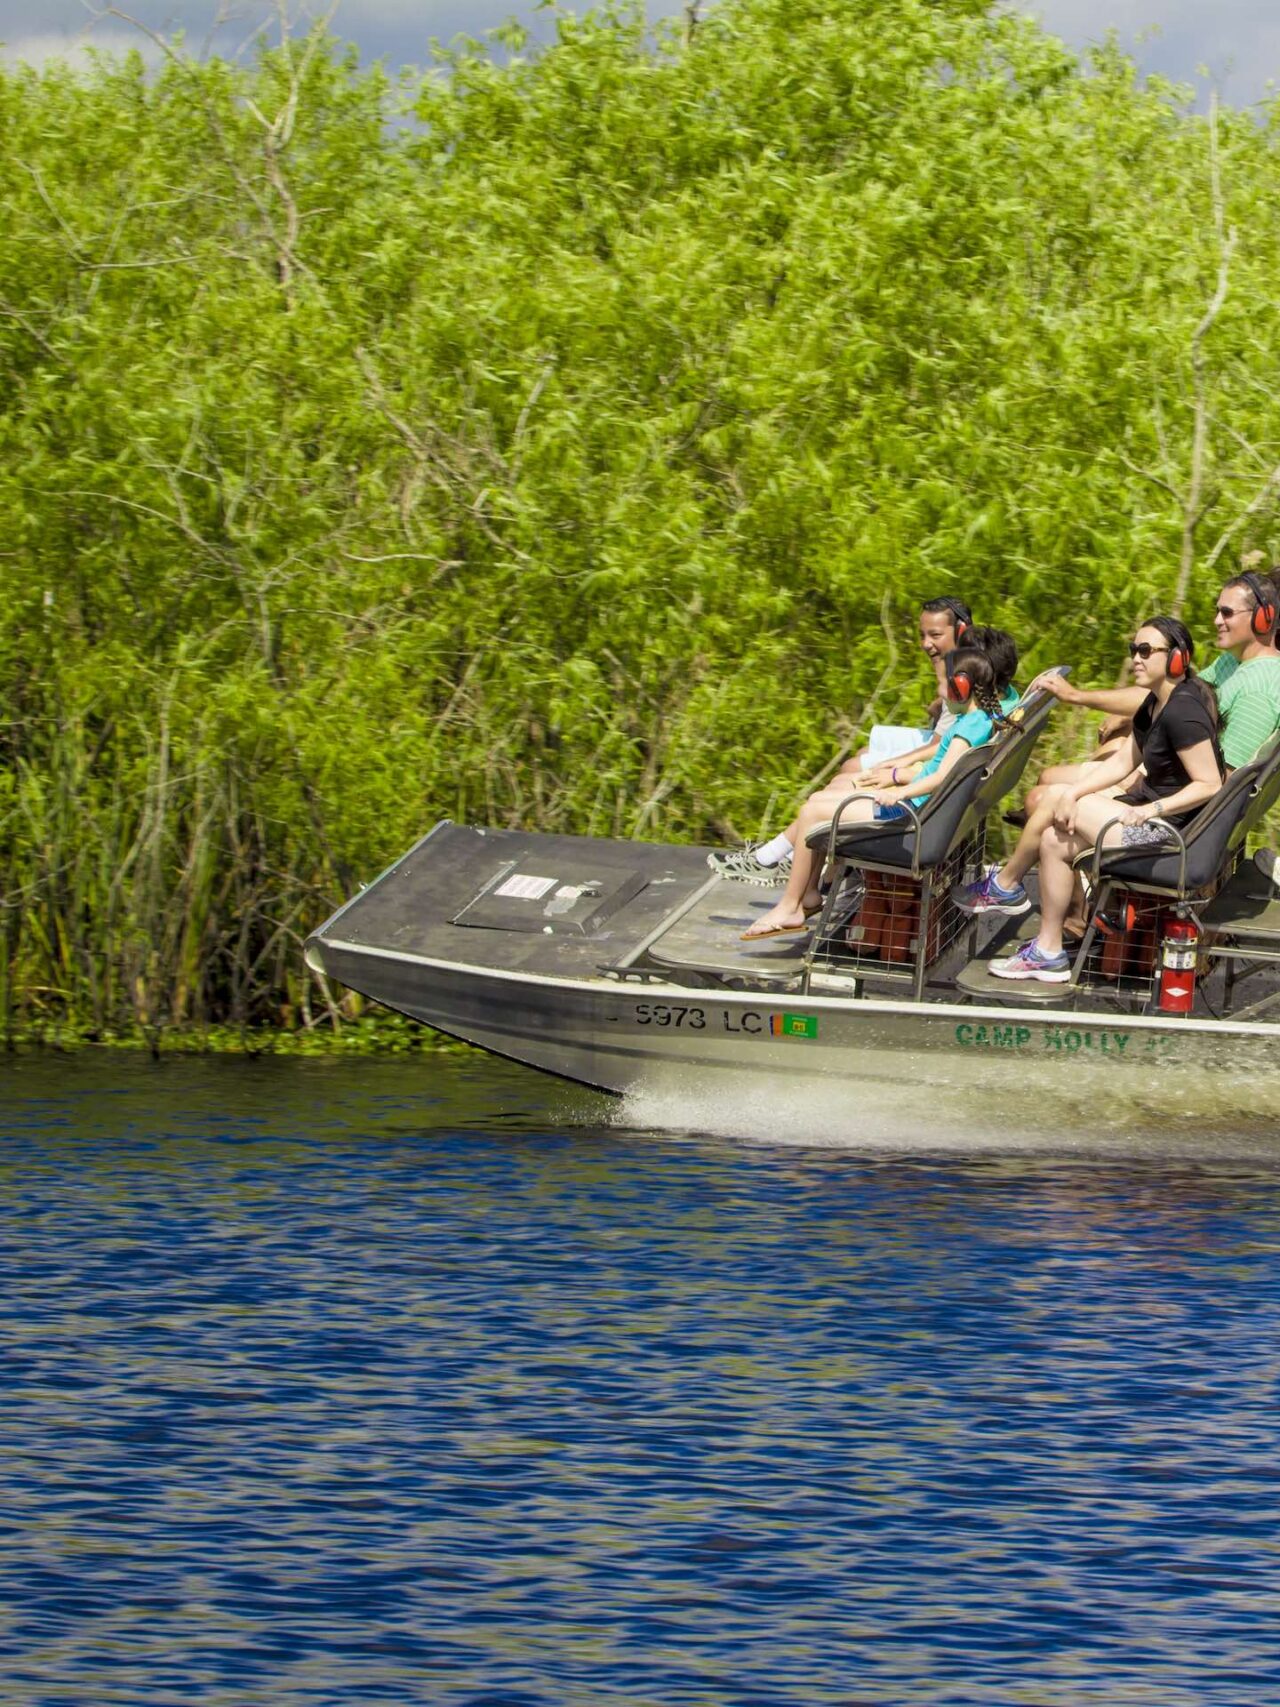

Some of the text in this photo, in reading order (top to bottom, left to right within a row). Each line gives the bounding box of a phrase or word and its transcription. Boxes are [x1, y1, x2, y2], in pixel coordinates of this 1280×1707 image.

[635, 1004, 705, 1030] 5973
[723, 1011, 762, 1034] LC
[955, 1023, 1031, 1047] CAMP
[1043, 1027, 1130, 1053] HOLLY
